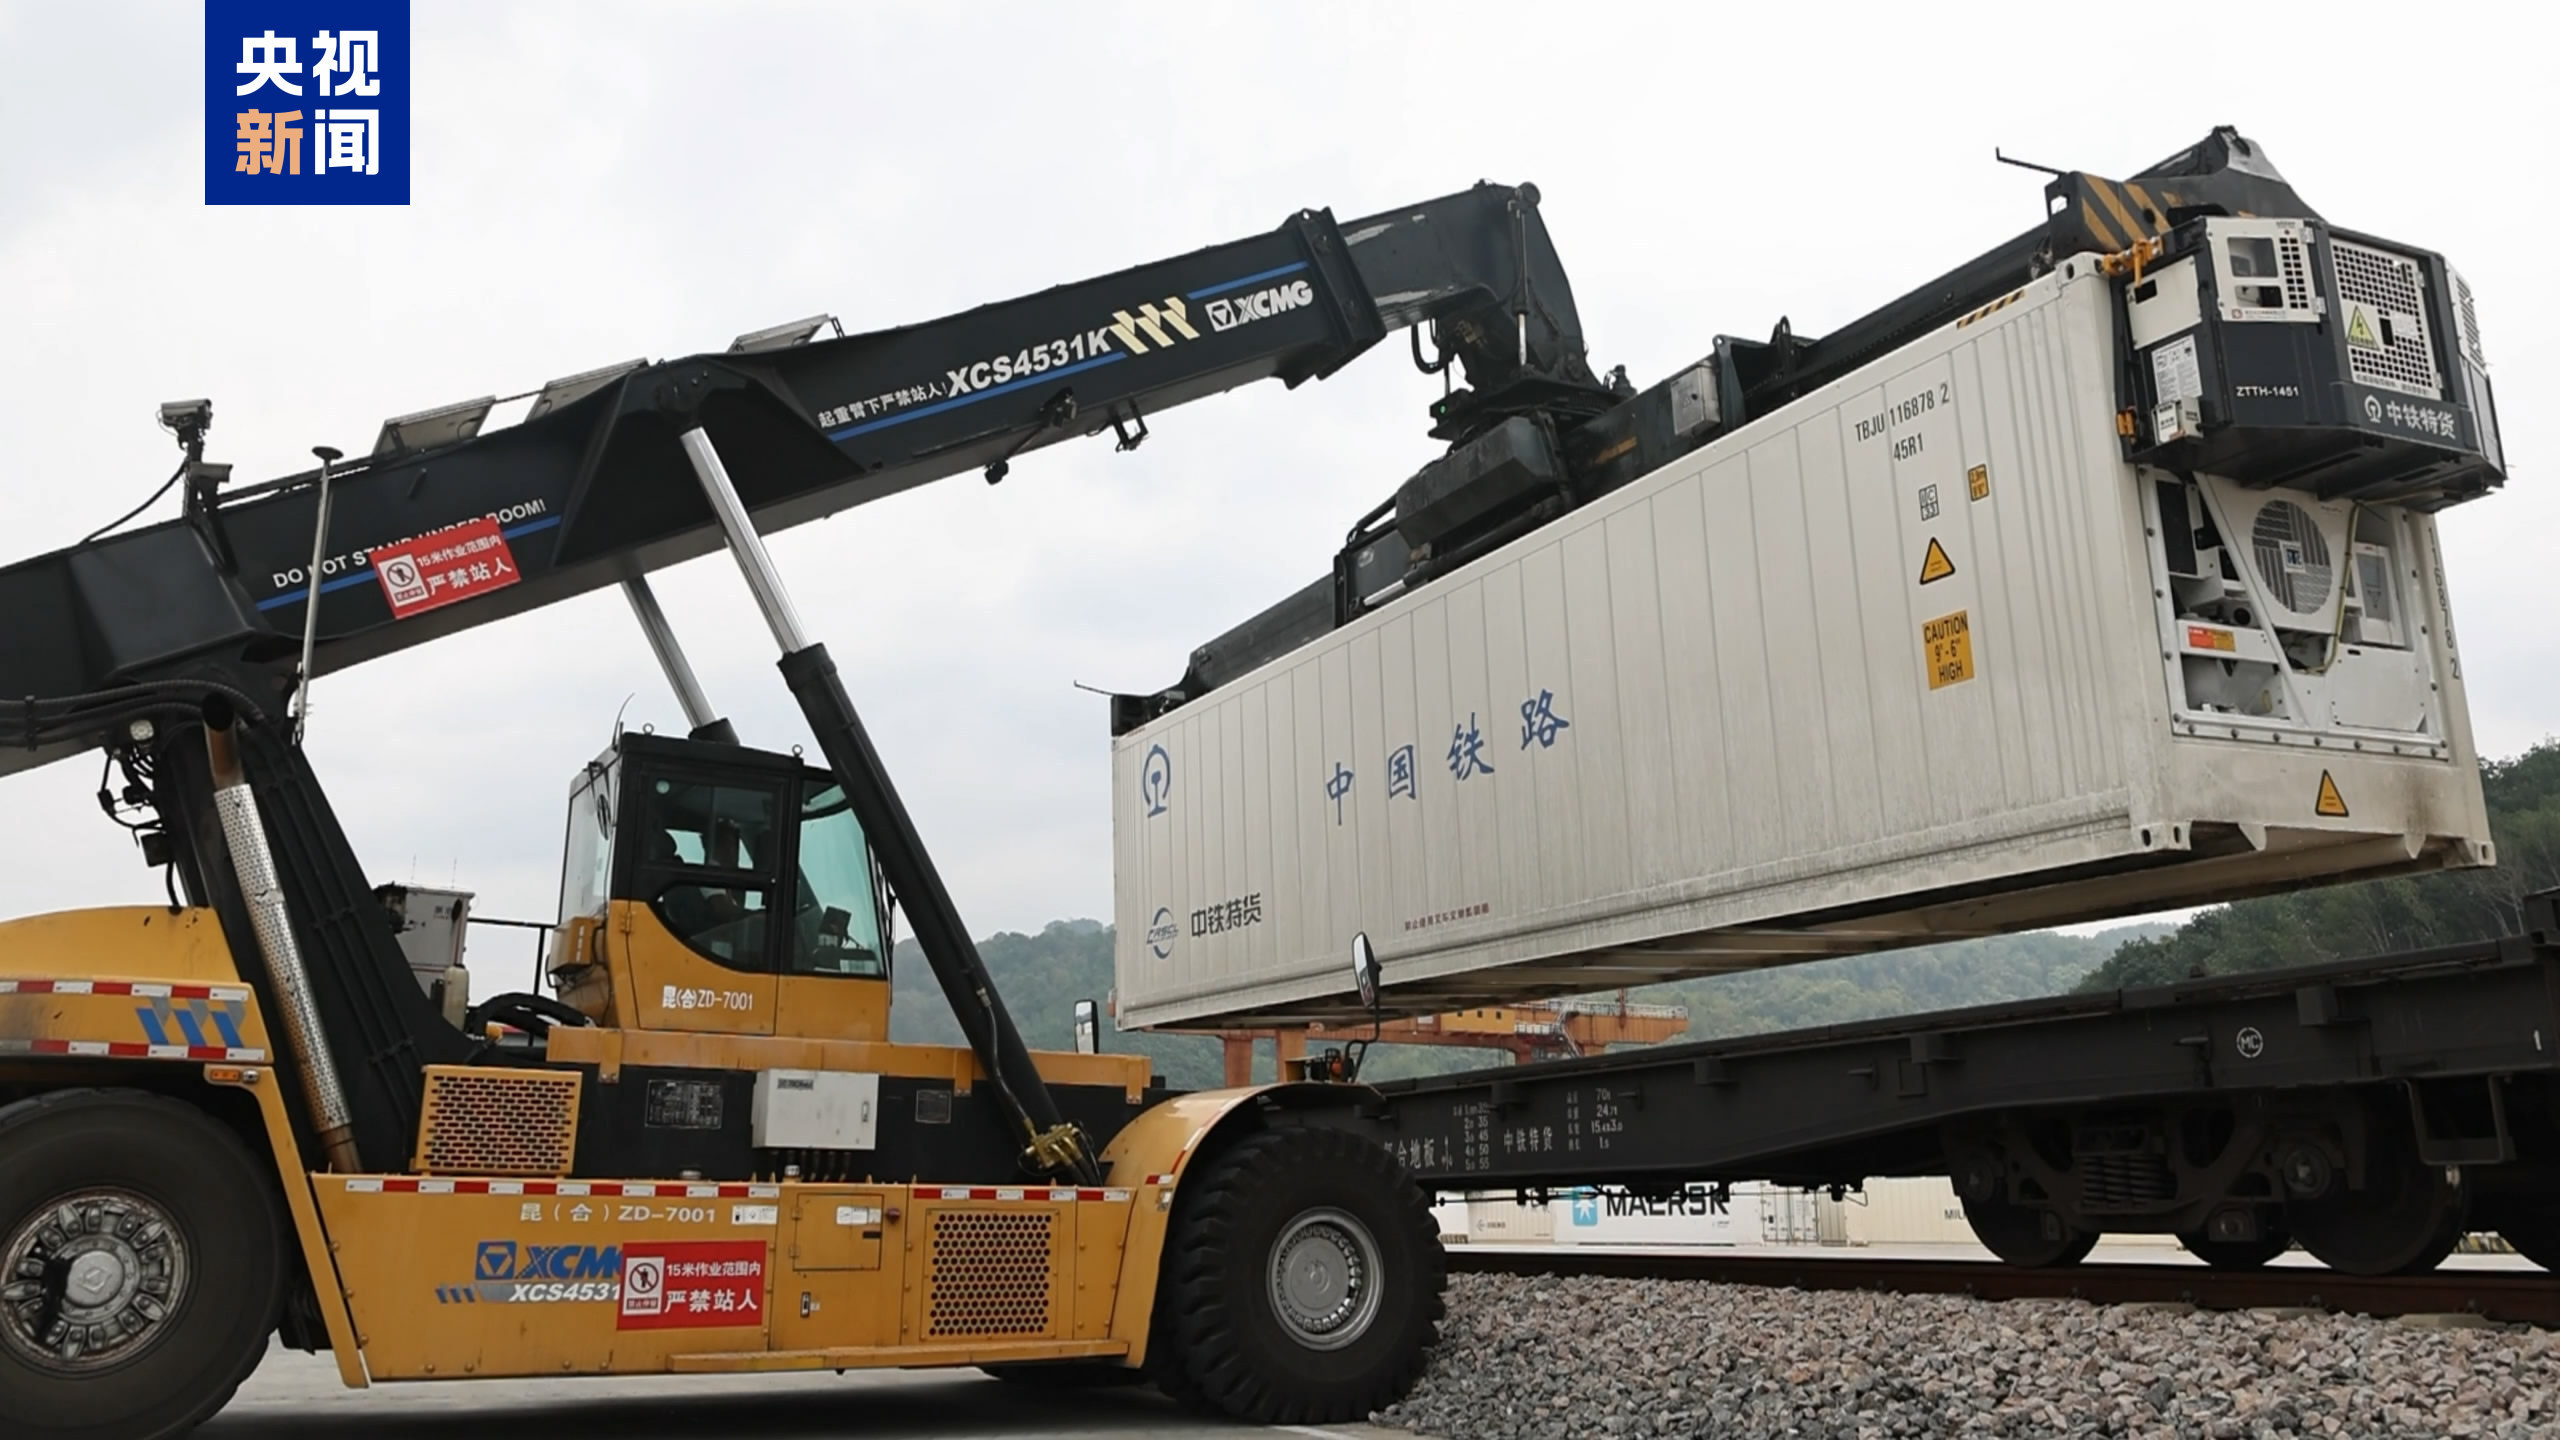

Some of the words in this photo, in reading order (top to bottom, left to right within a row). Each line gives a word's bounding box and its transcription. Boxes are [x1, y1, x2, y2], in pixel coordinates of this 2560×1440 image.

[1233, 281, 1313, 325] XCMG
[946, 328, 1112, 398] XCS4531K
[1855, 412, 1885, 443] TBJU
[1889, 389, 1935, 427] 116878
[1940, 381, 1950, 405] 2
[2386, 400, 2456, 439] 中铁特货
[1894, 432, 1924, 462] 45R1
[416, 534, 502, 567] 15米作业范围内
[272, 568, 304, 588] DO
[307, 555, 347, 576] OT
[426, 556, 513, 596] 严禁站人
[1924, 613, 1969, 644] CAUTION
[1938, 659, 1964, 684] HIGH
[1327, 689, 1570, 826] 中国铁路
[1191, 892, 1262, 938] 中铁特货
[516, 1246, 622, 1279] XCM
[666, 1260, 761, 1277] 15米作业范围内
[664, 1288, 759, 1314] 严禁站人
